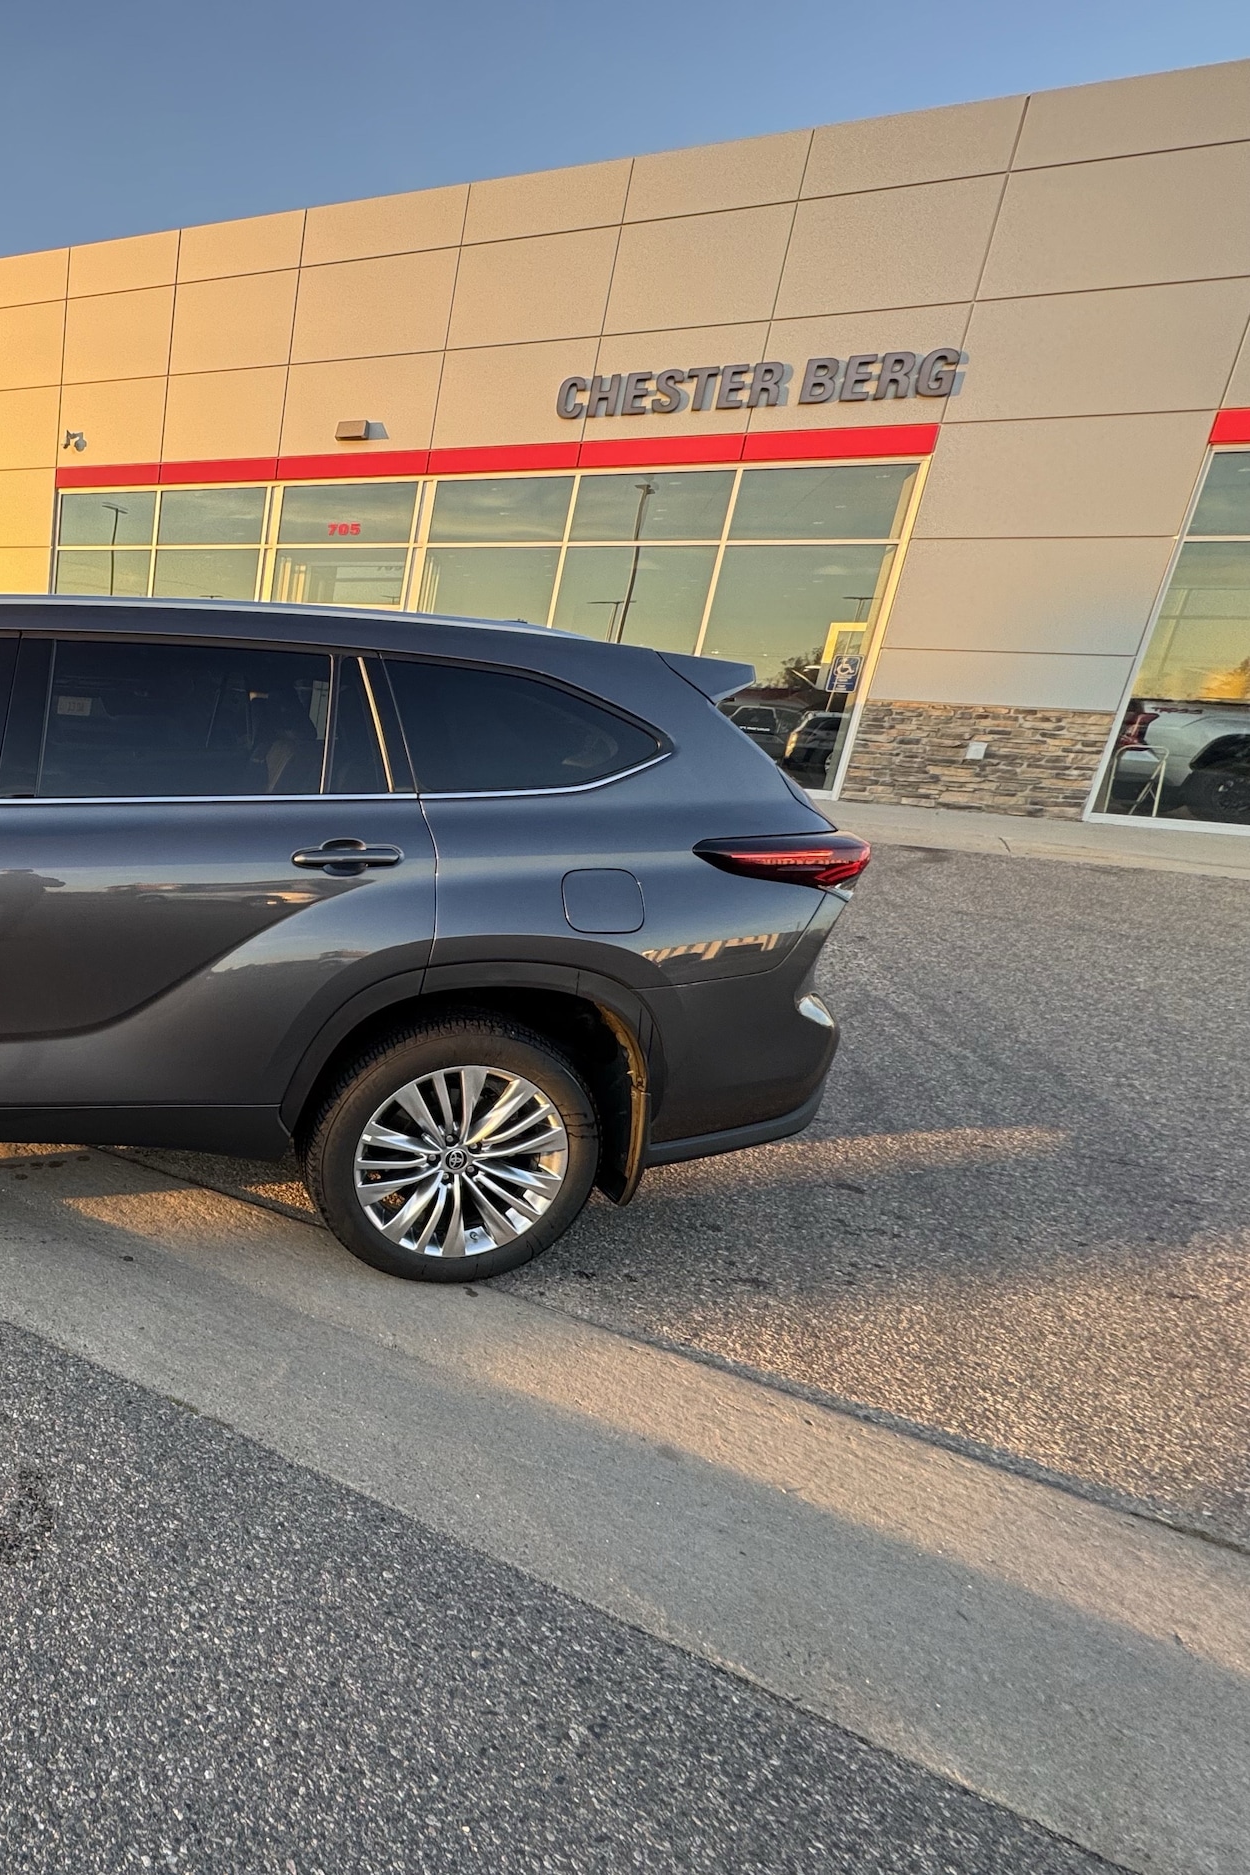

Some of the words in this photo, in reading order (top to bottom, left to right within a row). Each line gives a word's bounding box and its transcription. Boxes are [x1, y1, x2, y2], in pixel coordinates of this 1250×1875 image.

[556, 361, 786, 420] CHESTER
[798, 347, 962, 405] BERG
[327, 522, 361, 536] 705
